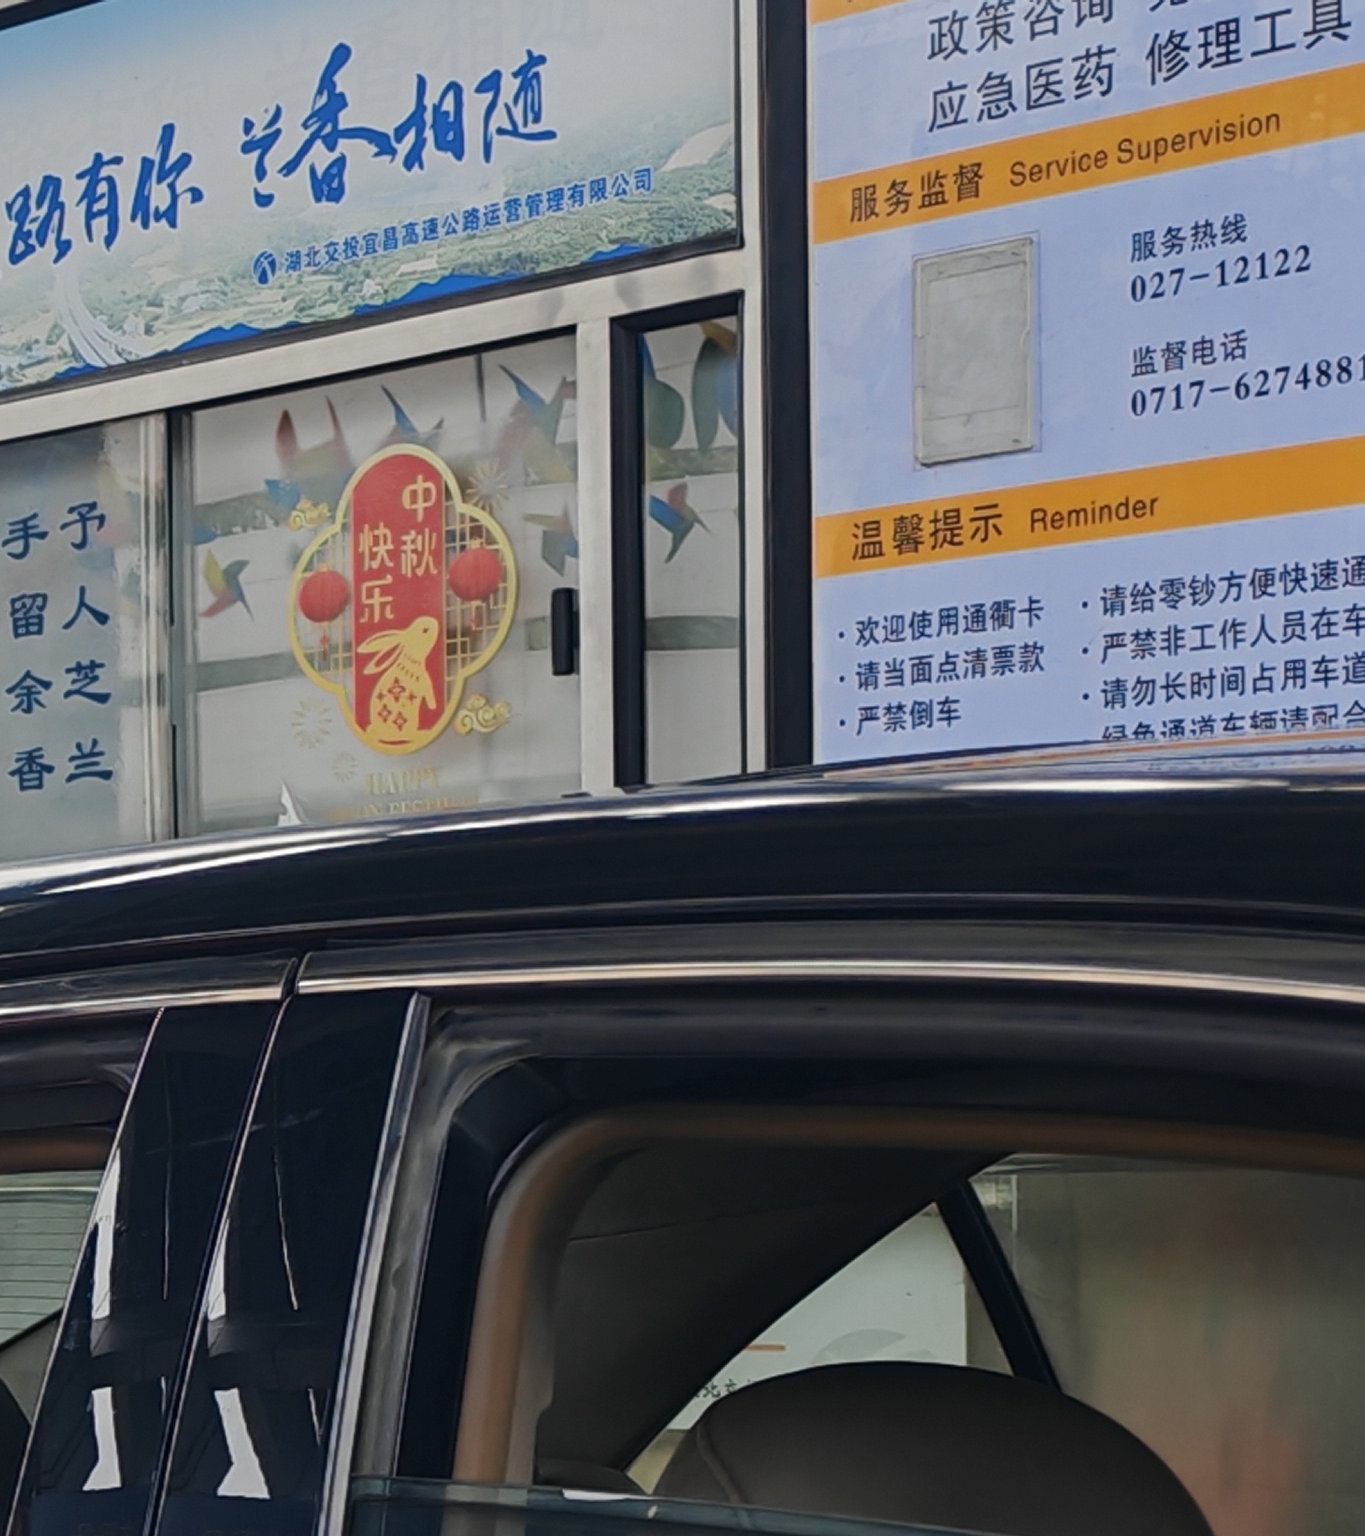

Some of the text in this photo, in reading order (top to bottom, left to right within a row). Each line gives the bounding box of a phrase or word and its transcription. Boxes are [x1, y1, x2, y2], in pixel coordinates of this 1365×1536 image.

[927, 0, 1352, 133] 应急医药 修理工具
[1009, 110, 1281, 187] Service Supervision
[284, 166, 653, 275] 湖北交投宜昌高速公路运营管理有限公司
[849, 162, 984, 223] 服务监督
[1130, 213, 1248, 263] 服务热线
[1130, 244, 1312, 303] 027-12122
[1131, 329, 1248, 378] 监督电话
[400, 474, 439, 578] 中秋
[851, 503, 1003, 561] 温馨提示
[1030, 497, 1160, 533] Reminder
[357, 528, 395, 625] 快乐
[1100, 555, 1365, 618] 请给零钞方便快速通
[2, 511, 57, 792] 手留余香
[59, 501, 114, 784] 予人芝兰
[855, 596, 1045, 647] 欢迎使用通衢卡
[1101, 603, 1365, 664] 严禁非工作人员在车
[855, 641, 1045, 692] 请当面点清票款
[1101, 651, 1365, 710] 请勿长时间占用车道
[856, 697, 962, 736] 严禁倒车
